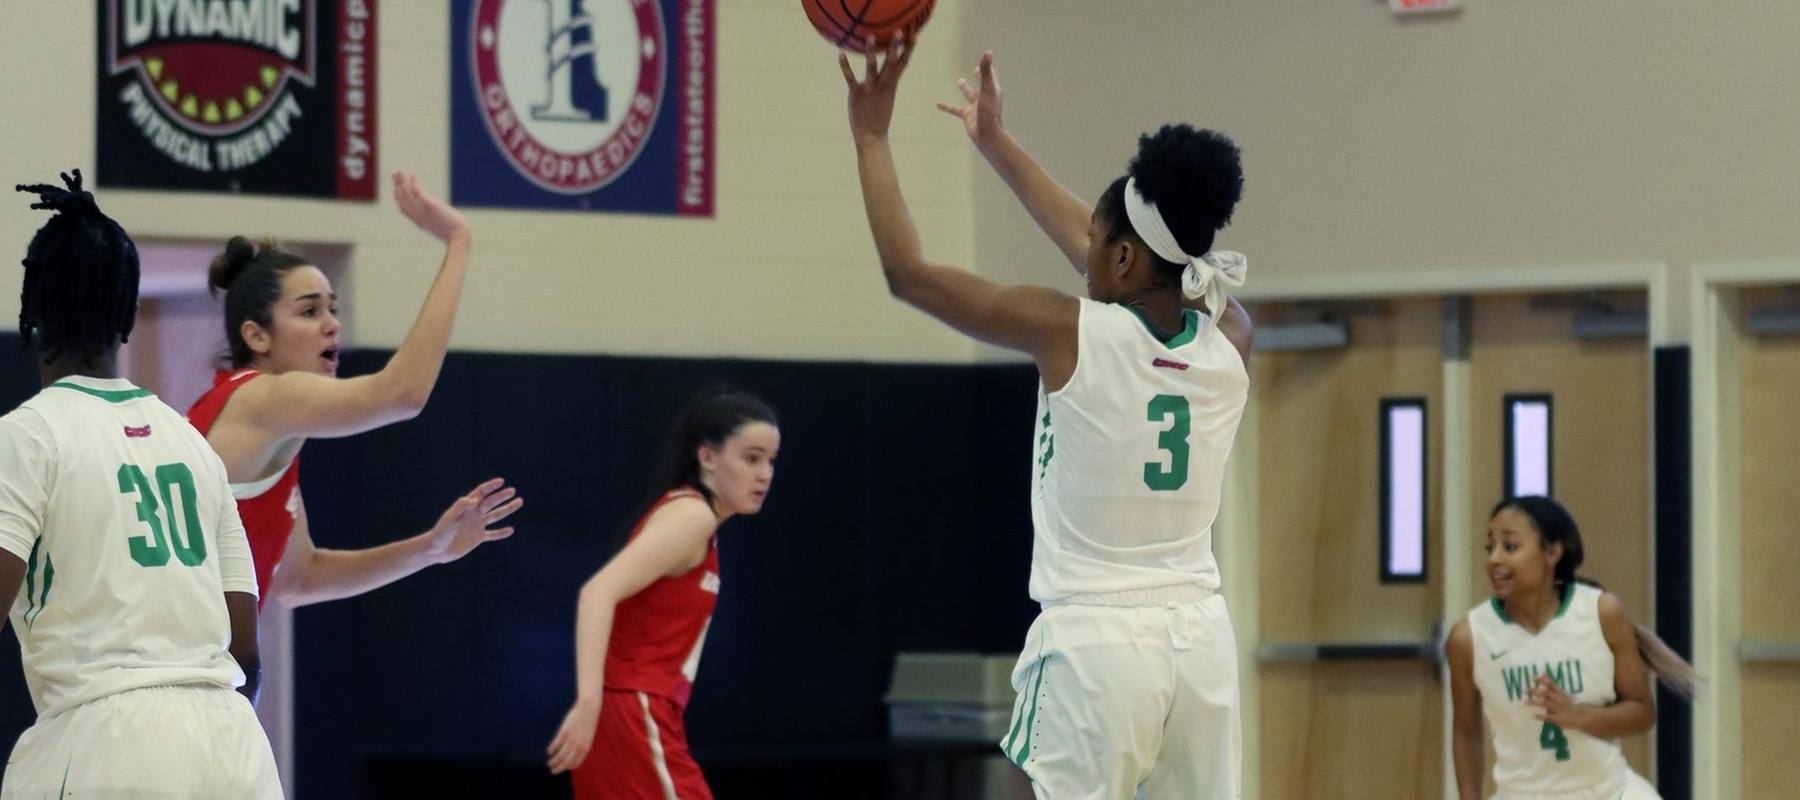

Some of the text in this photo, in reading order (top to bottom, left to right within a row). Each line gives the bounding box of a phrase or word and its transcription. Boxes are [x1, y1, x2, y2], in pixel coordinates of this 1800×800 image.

[123, 0, 300, 60] DYNAMIC
[119, 82, 303, 172] PHYSICAL THERAPY
[486, 83, 654, 183] ORTHOPAEDICS
[1143, 394, 1191, 491] 3
[117, 462, 208, 568] 30
[1540, 720, 1571, 762] 4
